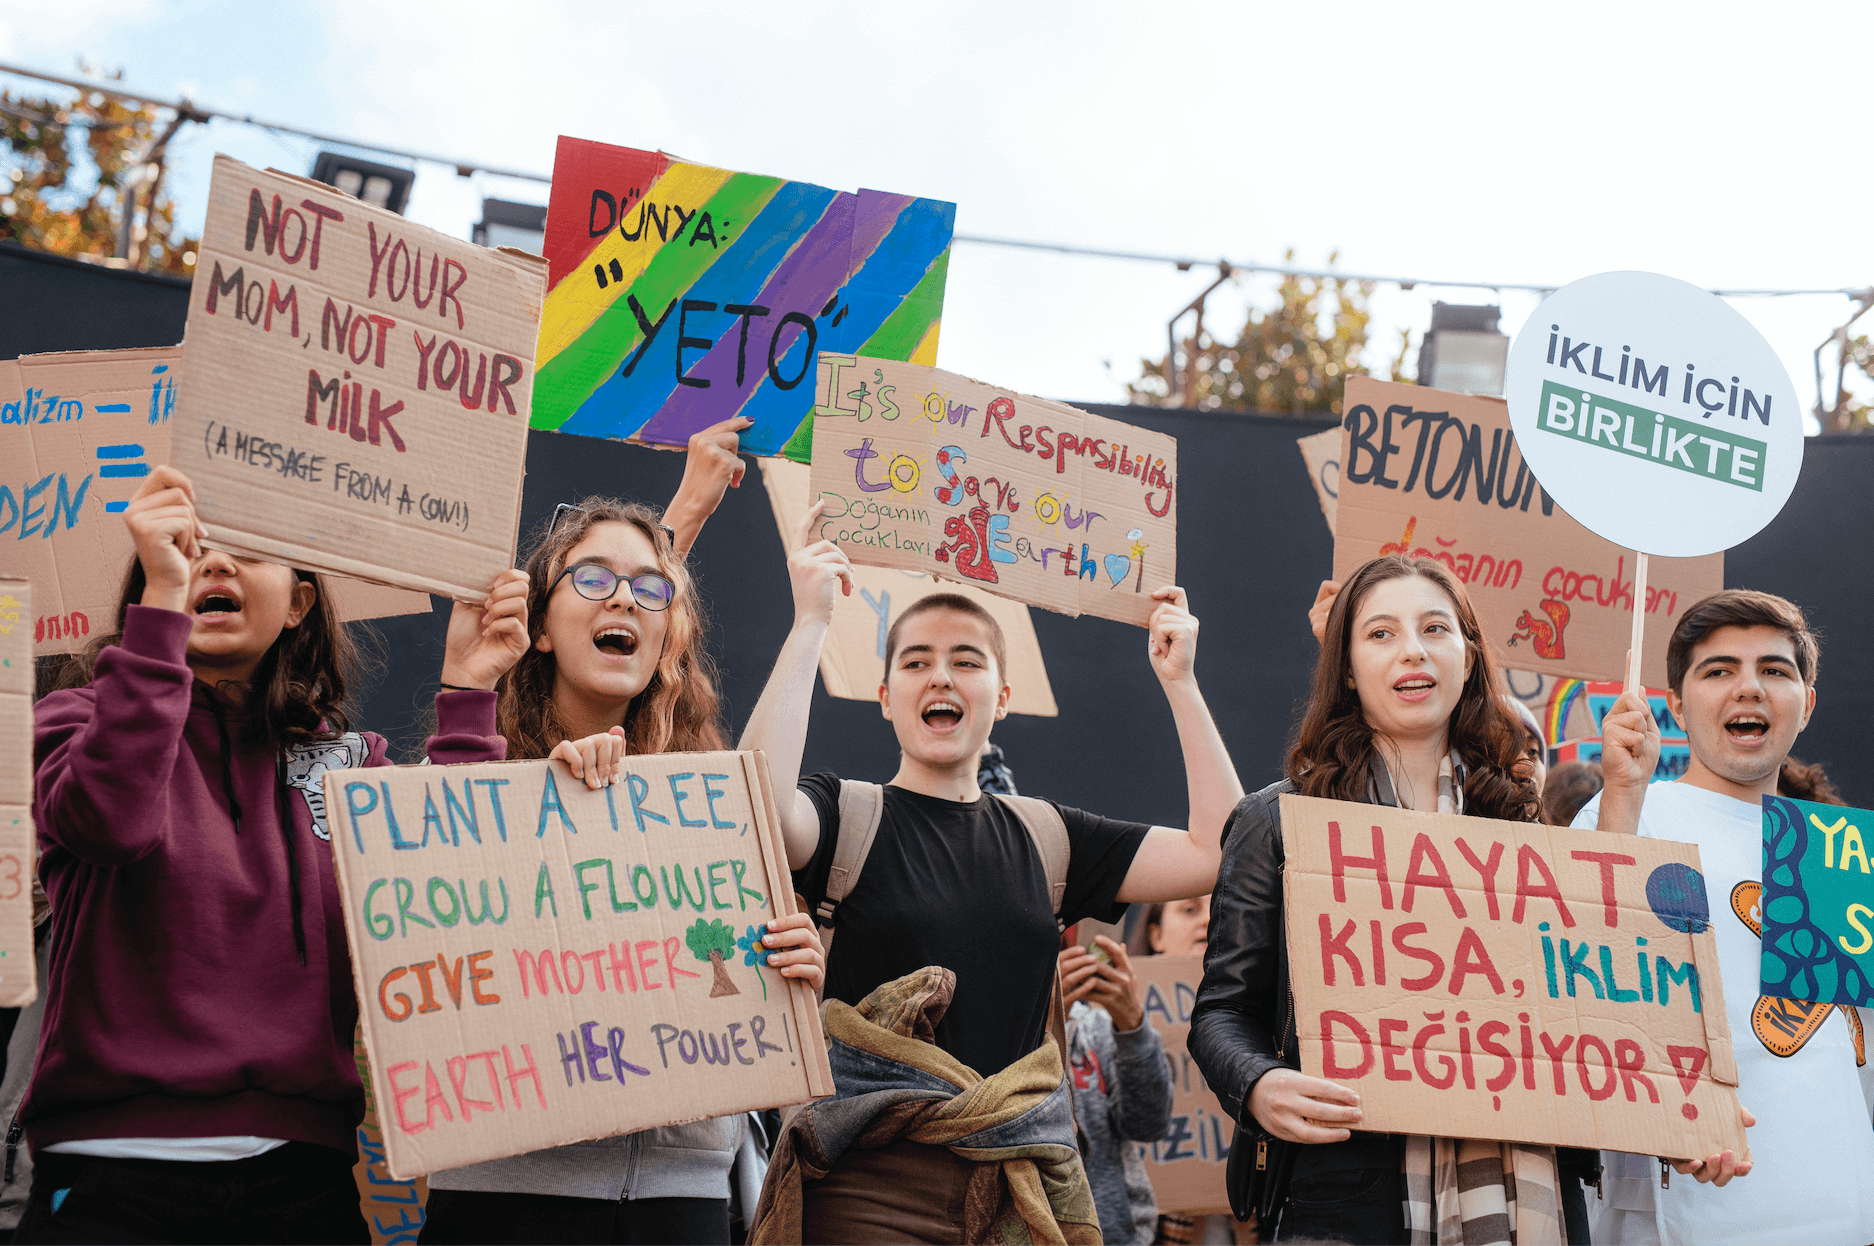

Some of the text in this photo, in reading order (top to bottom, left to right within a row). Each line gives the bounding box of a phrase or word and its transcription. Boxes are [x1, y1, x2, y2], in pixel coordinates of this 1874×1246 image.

[244, 188, 468, 330] NOT YOUR
[588, 187, 730, 249] DÜNYA:
[205, 260, 523, 416] MOM, NOT YOUR
[1546, 323, 1773, 427] İKLİM İÇİN
[814, 356, 900, 422] It's
[234, 430, 327, 483] MESSAGE
[334, 462, 391, 506] FROM
[396, 484, 416, 516] A
[934, 445, 1020, 512] Save
[1545, 392, 1759, 485] BİRLİKTE
[988, 514, 1097, 582] Earth
[343, 776, 510, 854] PLANT
[535, 765, 578, 839] A
[1809, 813, 1874, 874] YA
[363, 858, 770, 941] GROW A FLOWER,
[1326, 820, 1637, 929] HAYAT
[378, 936, 701, 1023] GIVE MOTHER
[1318, 913, 1702, 1014] KISA, İKLİM
[386, 1043, 549, 1137] EARTH
[556, 1020, 650, 1088] HER
[650, 1012, 798, 1069] POWER!
